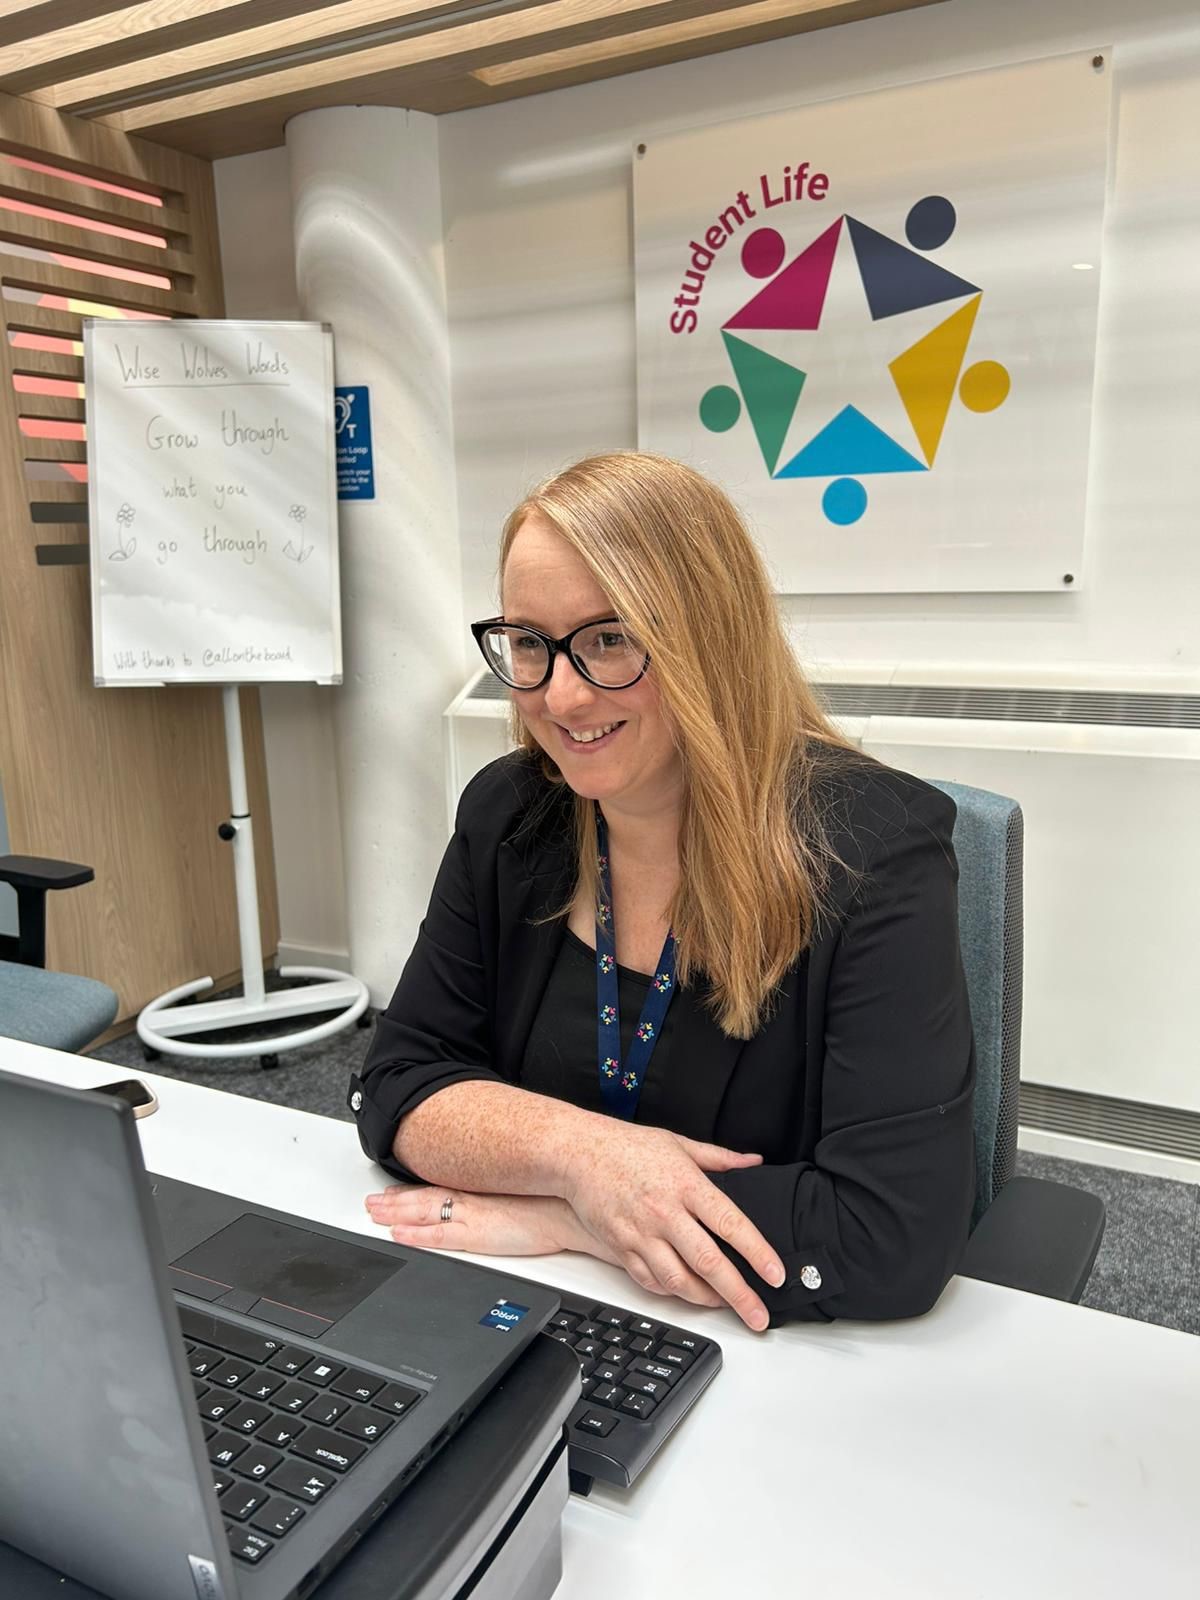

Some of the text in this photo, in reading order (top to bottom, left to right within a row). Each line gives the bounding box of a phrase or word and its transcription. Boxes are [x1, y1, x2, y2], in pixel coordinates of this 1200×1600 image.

[670, 162, 829, 334] Student Life
[115, 341, 290, 382] Wise Wolves Words
[145, 409, 290, 456] Grow through
[347, 424, 357, 438] T
[162, 476, 249, 510] what you
[157, 526, 268, 565] go through
[113, 650, 137, 670] With
[142, 650, 175, 669] thanks
[183, 651, 193, 667] to
[490, 1308, 519, 1321] vPRO
[257, 1387, 270, 1395] X
[289, 1399, 302, 1408] Z
[212, 1407, 224, 1415] D
[244, 1420, 255, 1428] S
[278, 1432, 289, 1440] A
[217, 1451, 232, 1460] W
[253, 1464, 265, 1474] Q
